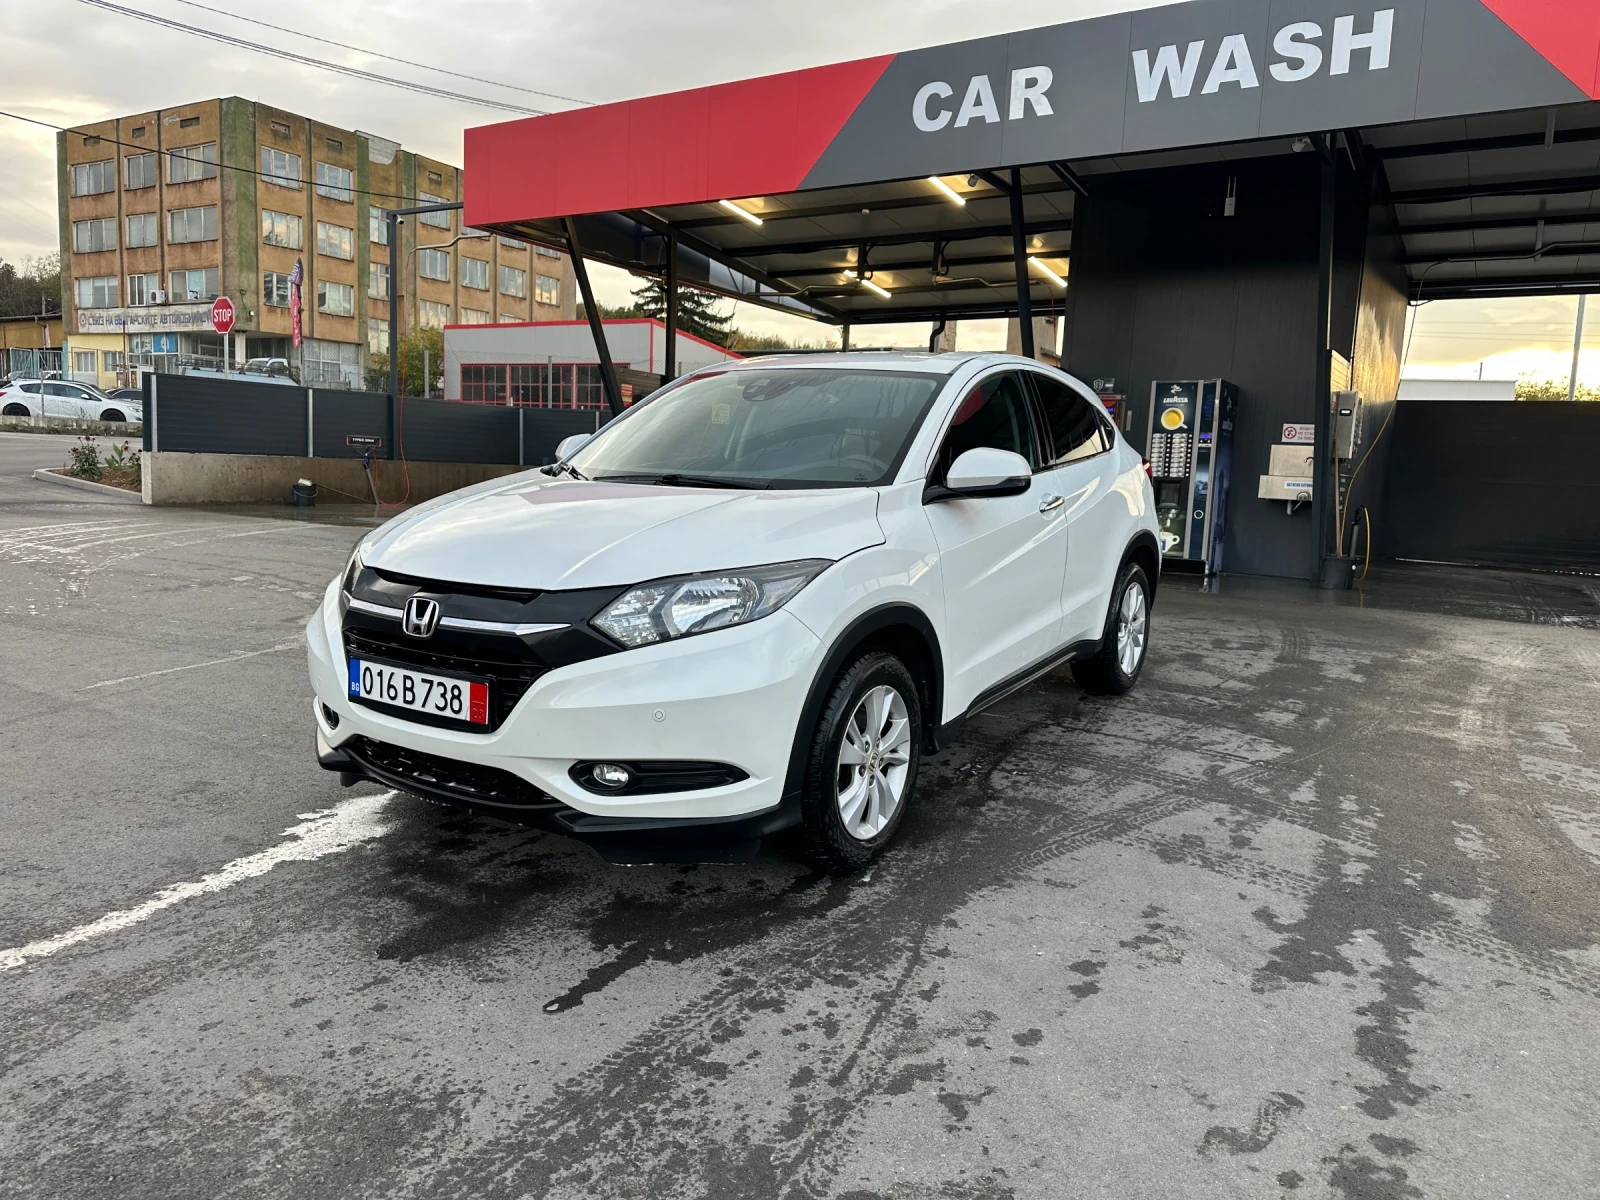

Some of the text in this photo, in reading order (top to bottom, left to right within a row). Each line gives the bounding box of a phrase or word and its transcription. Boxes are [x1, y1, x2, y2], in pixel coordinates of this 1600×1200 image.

[911, 8, 1395, 132] CAR WASH
[213, 308, 232, 323] STOP
[351, 681, 360, 692] BG
